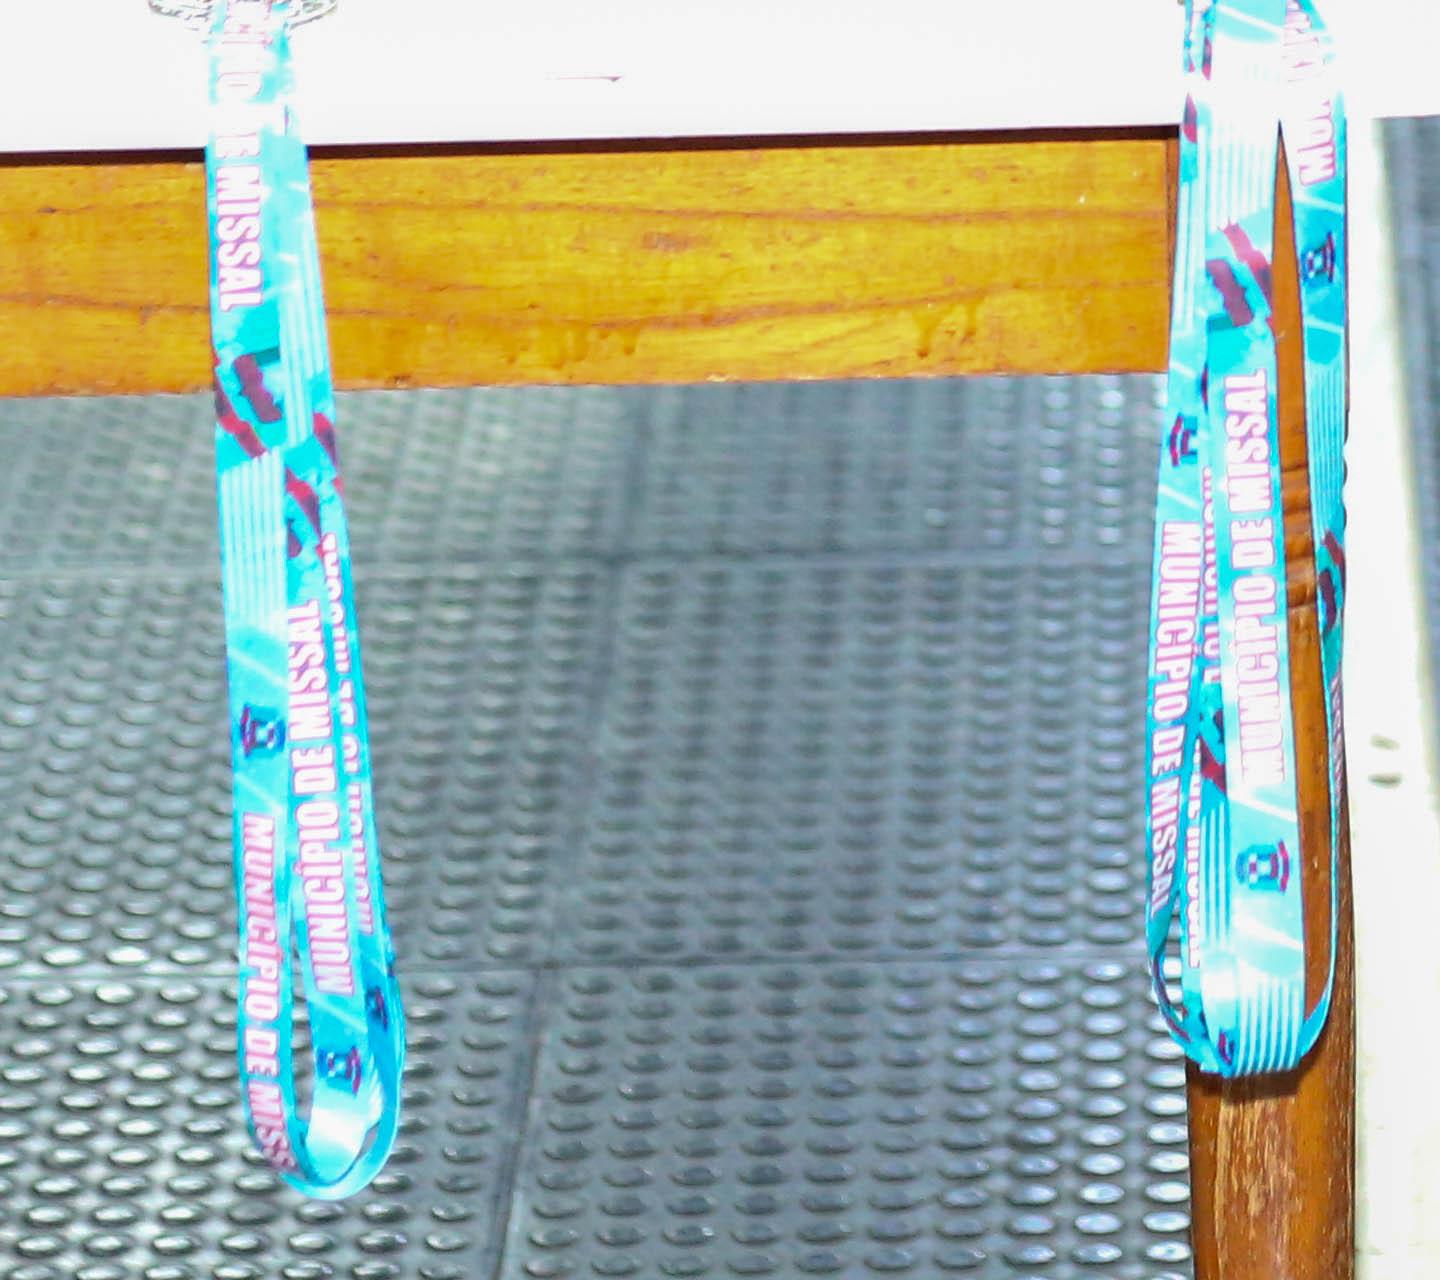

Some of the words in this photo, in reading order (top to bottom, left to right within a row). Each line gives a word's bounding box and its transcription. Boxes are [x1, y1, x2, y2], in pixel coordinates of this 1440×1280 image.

[216, 164, 264, 313] MISSAL
[1224, 368, 1272, 512] MISSAL
[1229, 516, 1275, 569] DE
[288, 600, 333, 739] MISSAL
[1153, 520, 1201, 720] MUNICÍPIO
[1228, 573, 1285, 786] MUNICÍPIO
[292, 744, 336, 796] DE
[1152, 721, 1183, 777] DE
[243, 812, 284, 1021] MUNICÍPIO
[293, 800, 355, 996] MUNICÍPIO
[245, 1027, 279, 1078] DE
